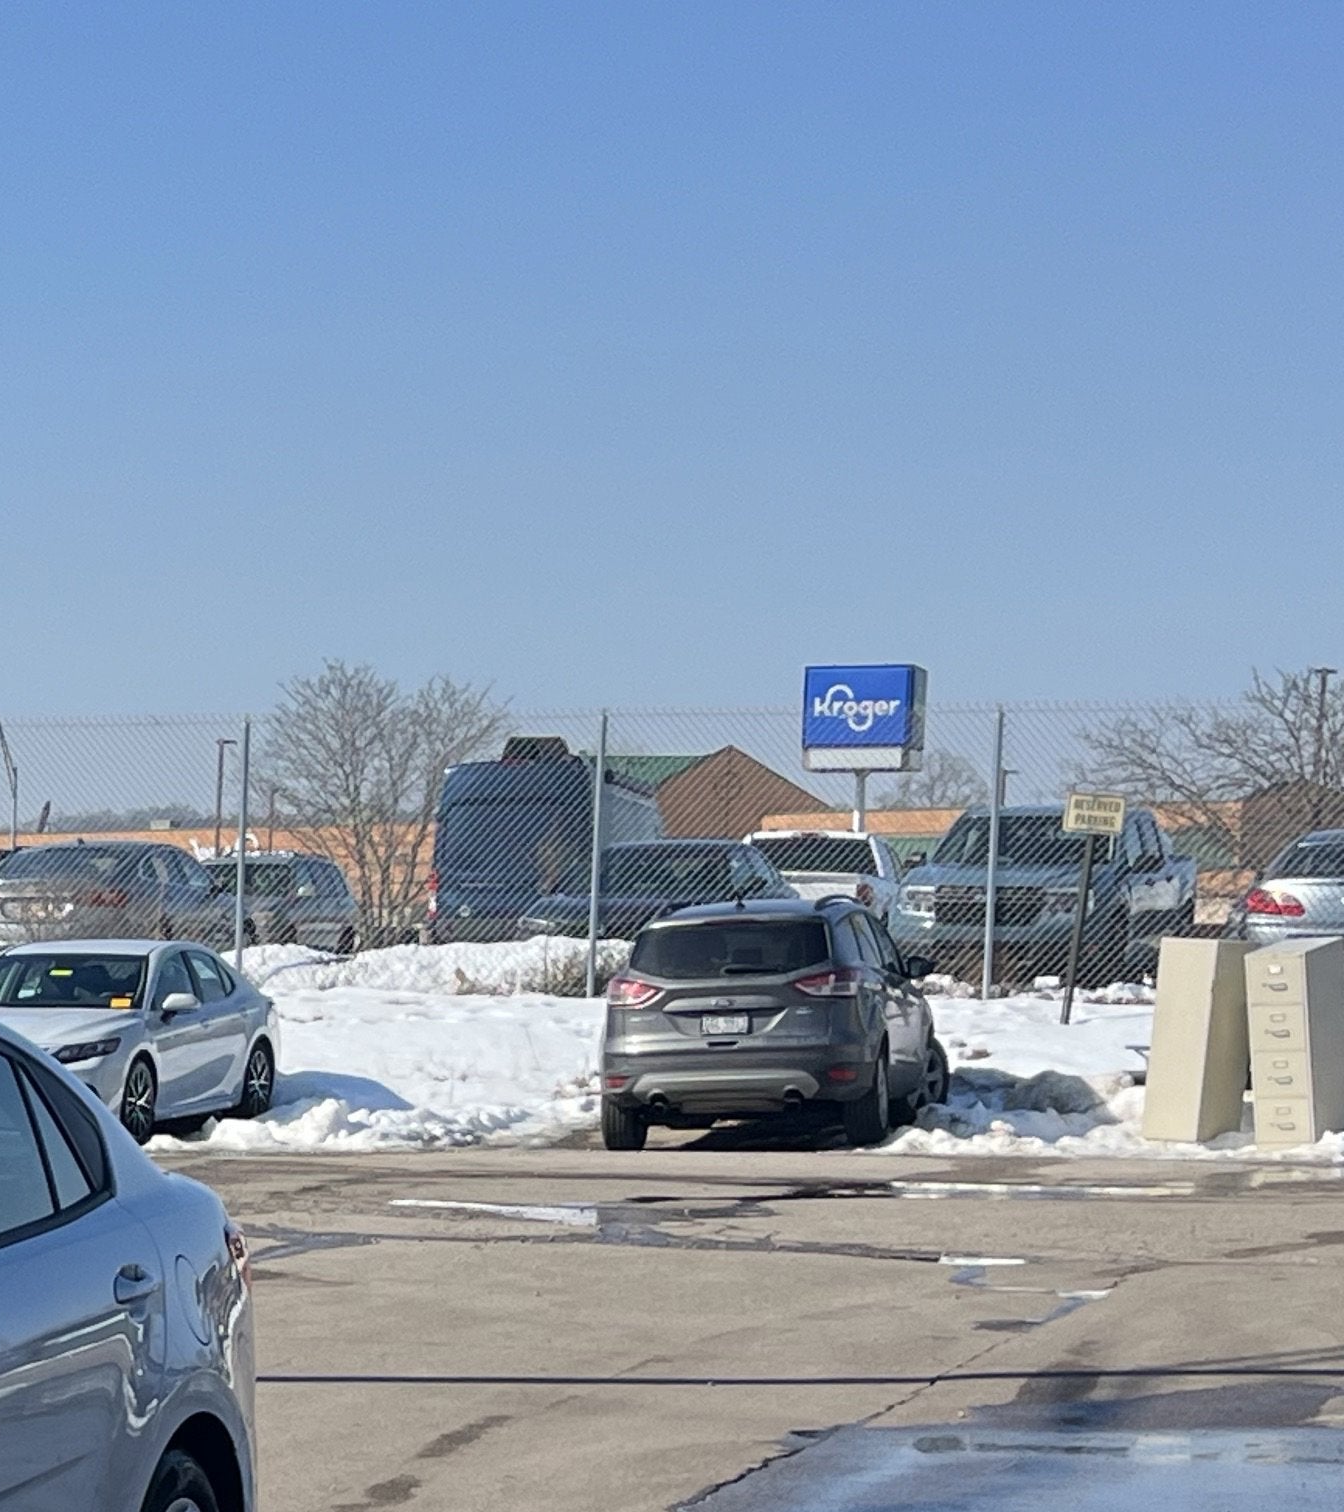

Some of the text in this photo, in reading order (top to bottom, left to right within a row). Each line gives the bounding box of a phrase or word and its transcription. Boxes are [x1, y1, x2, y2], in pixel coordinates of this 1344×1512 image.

[813, 684, 902, 733] Kroger
[1074, 798, 1121, 813] RESERVED
[1074, 812, 1117, 828] PARKING
